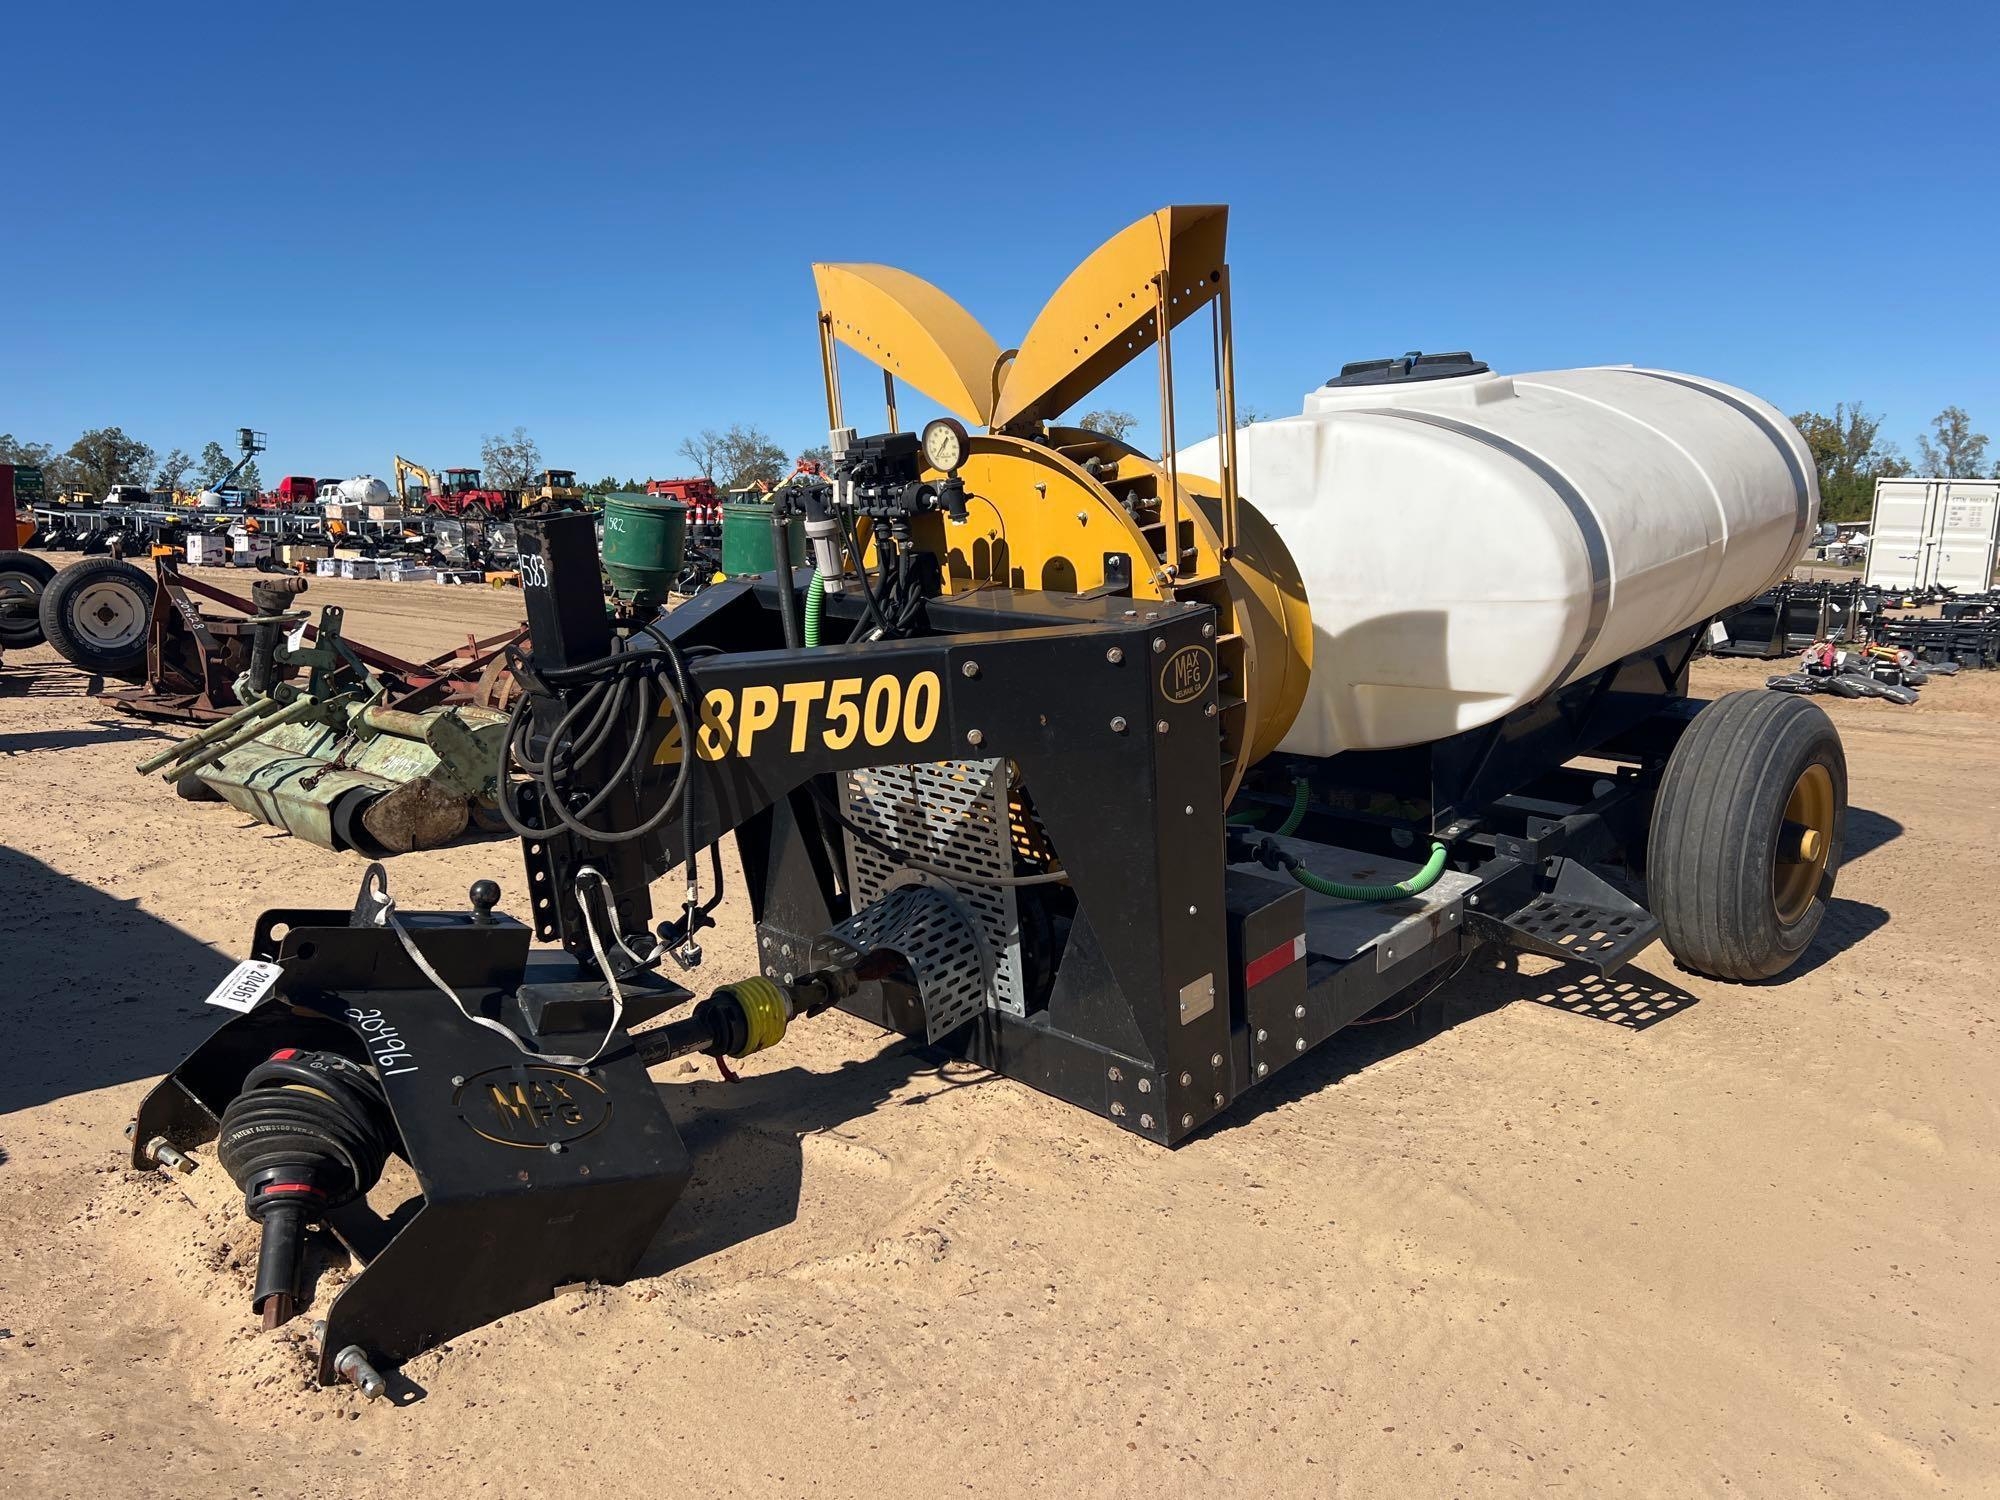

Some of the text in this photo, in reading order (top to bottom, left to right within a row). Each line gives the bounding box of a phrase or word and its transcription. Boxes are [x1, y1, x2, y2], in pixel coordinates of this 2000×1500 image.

[607, 517, 626, 533] 1582
[518, 553, 548, 590] 1583
[652, 670, 941, 766] 28PT500
[228, 970, 270, 1004] 204961
[344, 1008, 419, 1076] 204961
[232, 1127, 255, 1140] PATENT
